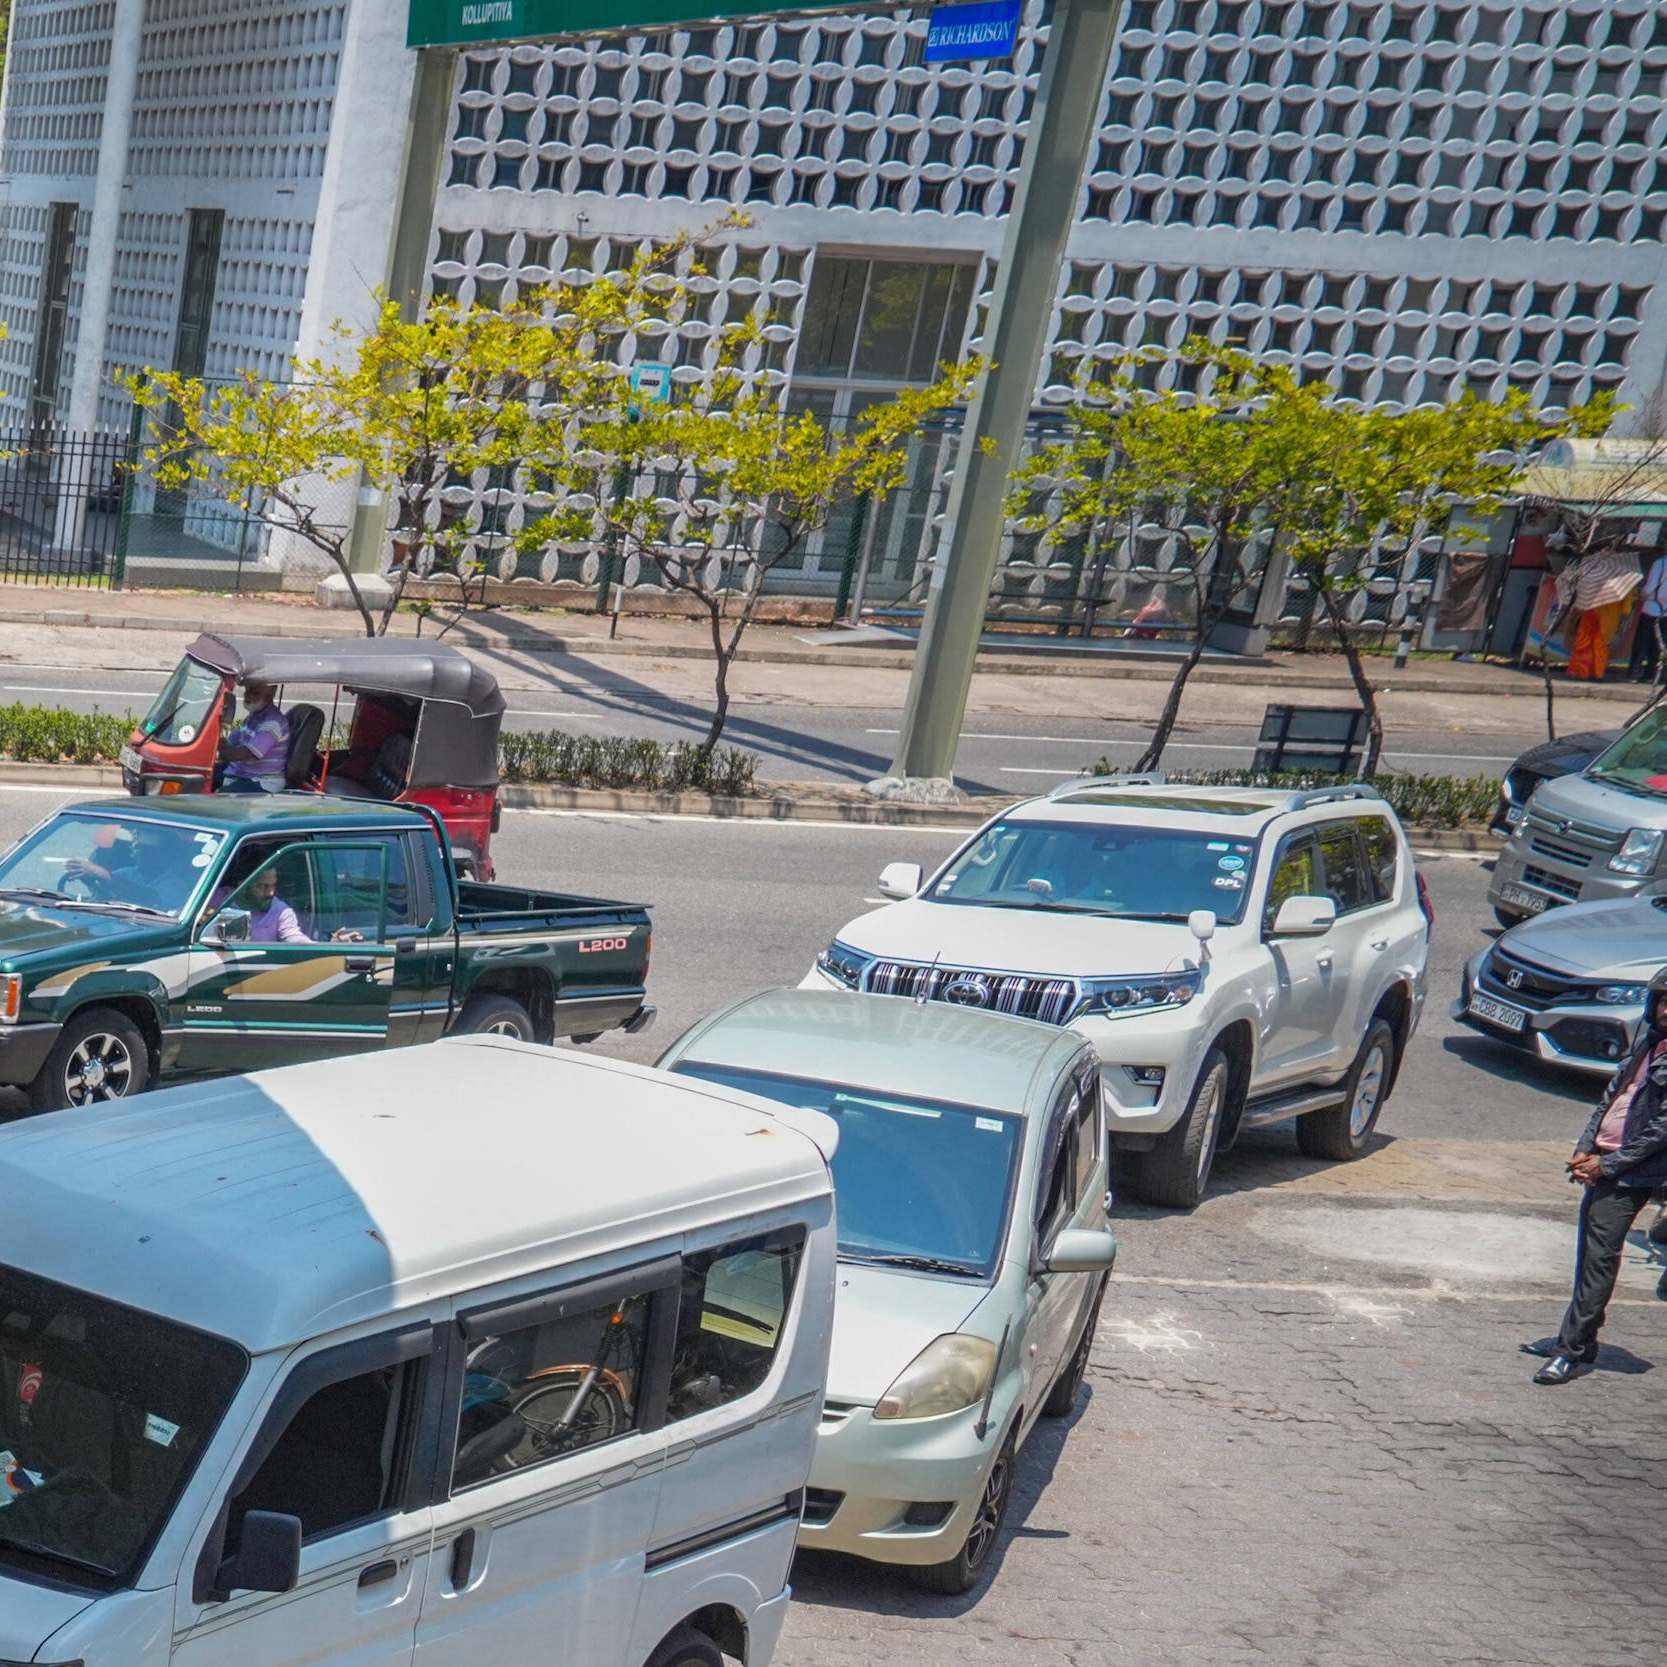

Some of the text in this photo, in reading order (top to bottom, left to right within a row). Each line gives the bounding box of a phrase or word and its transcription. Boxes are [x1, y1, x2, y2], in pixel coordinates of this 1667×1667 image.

[462, 2, 512, 25] KOLLUPITIYA
[939, 21, 1011, 46] RICHARDSON
[1214, 877, 1241, 888] DPL
[579, 938, 628, 953] L200
